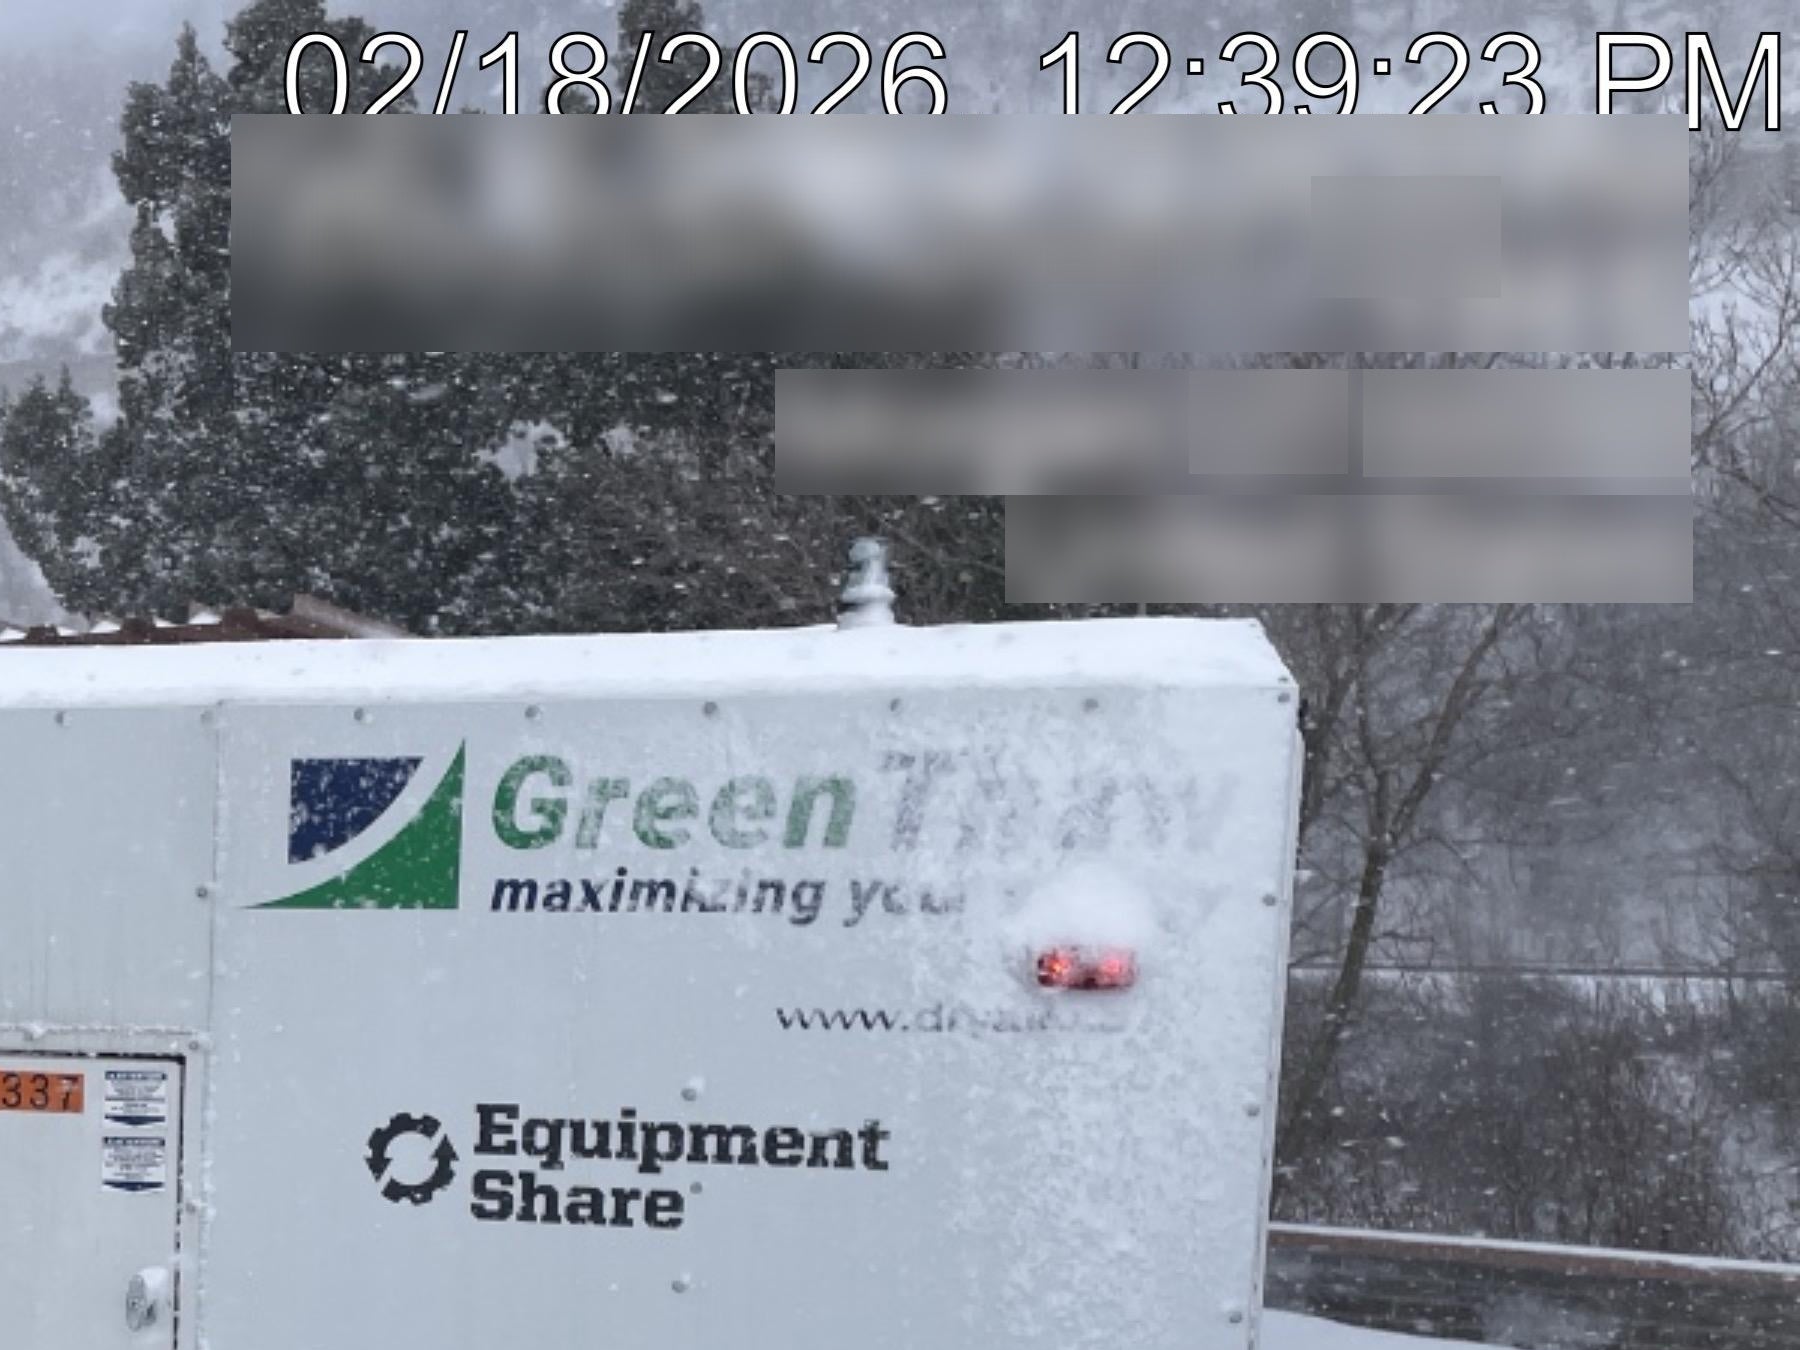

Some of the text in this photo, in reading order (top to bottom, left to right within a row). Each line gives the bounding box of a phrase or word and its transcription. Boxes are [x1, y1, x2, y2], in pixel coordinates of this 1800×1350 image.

[491, 754, 858, 850] Green
[489, 866, 826, 927] maximizing
[473, 1103, 891, 1174] Equipment
[470, 1169, 685, 1229] Share
